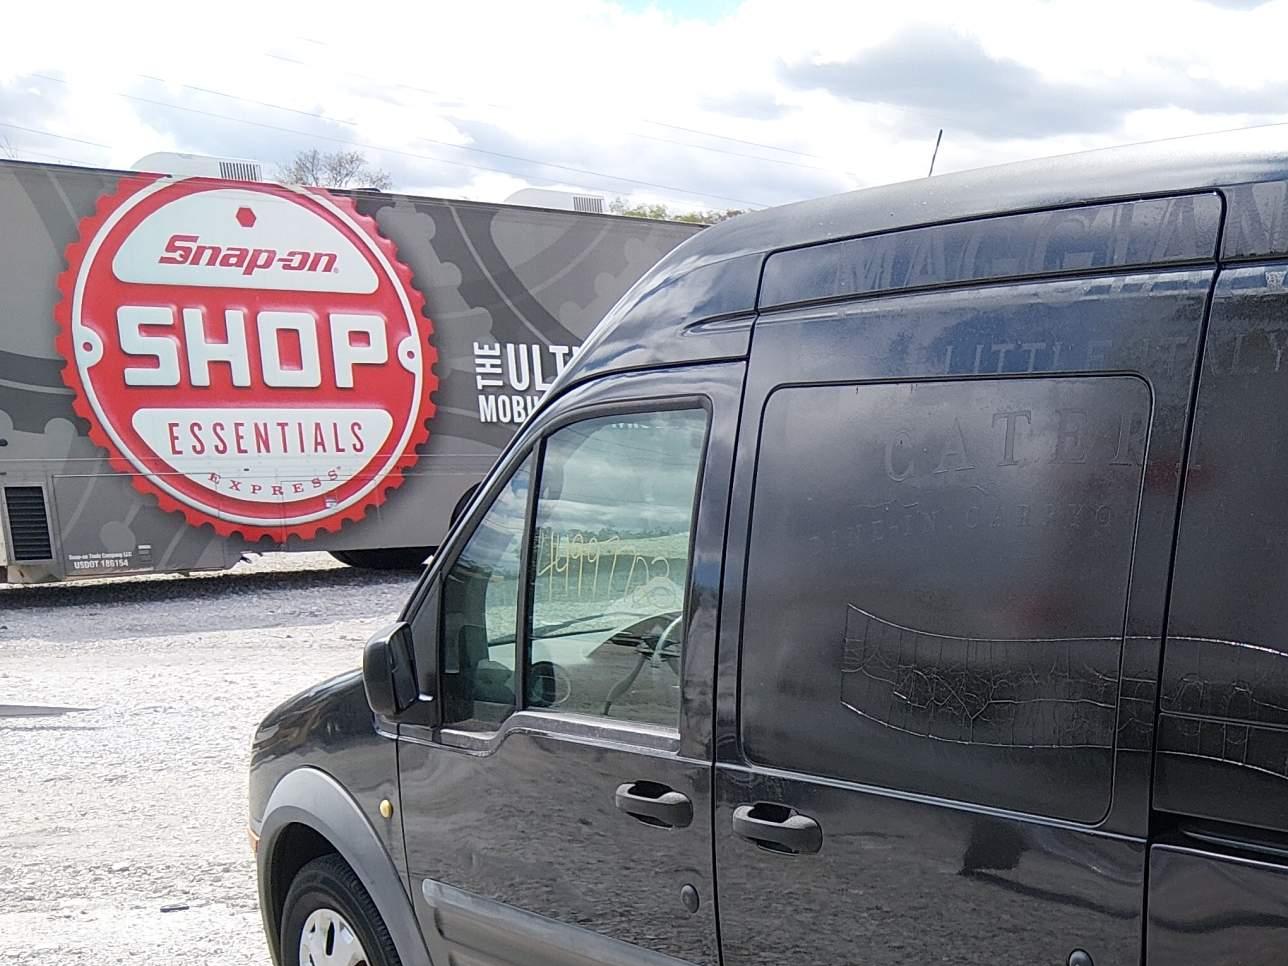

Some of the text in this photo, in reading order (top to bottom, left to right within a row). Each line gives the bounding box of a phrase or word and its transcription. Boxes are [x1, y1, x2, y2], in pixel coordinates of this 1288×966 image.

[158, 234, 338, 275] Snap-on
[116, 306, 389, 388] SHOP
[473, 342, 503, 390] THE
[506, 343, 581, 391] ULT
[168, 422, 365, 456] ESSENTIALS
[207, 469, 339, 497] EXPRESS
[74, 561, 98, 569] USDOT
